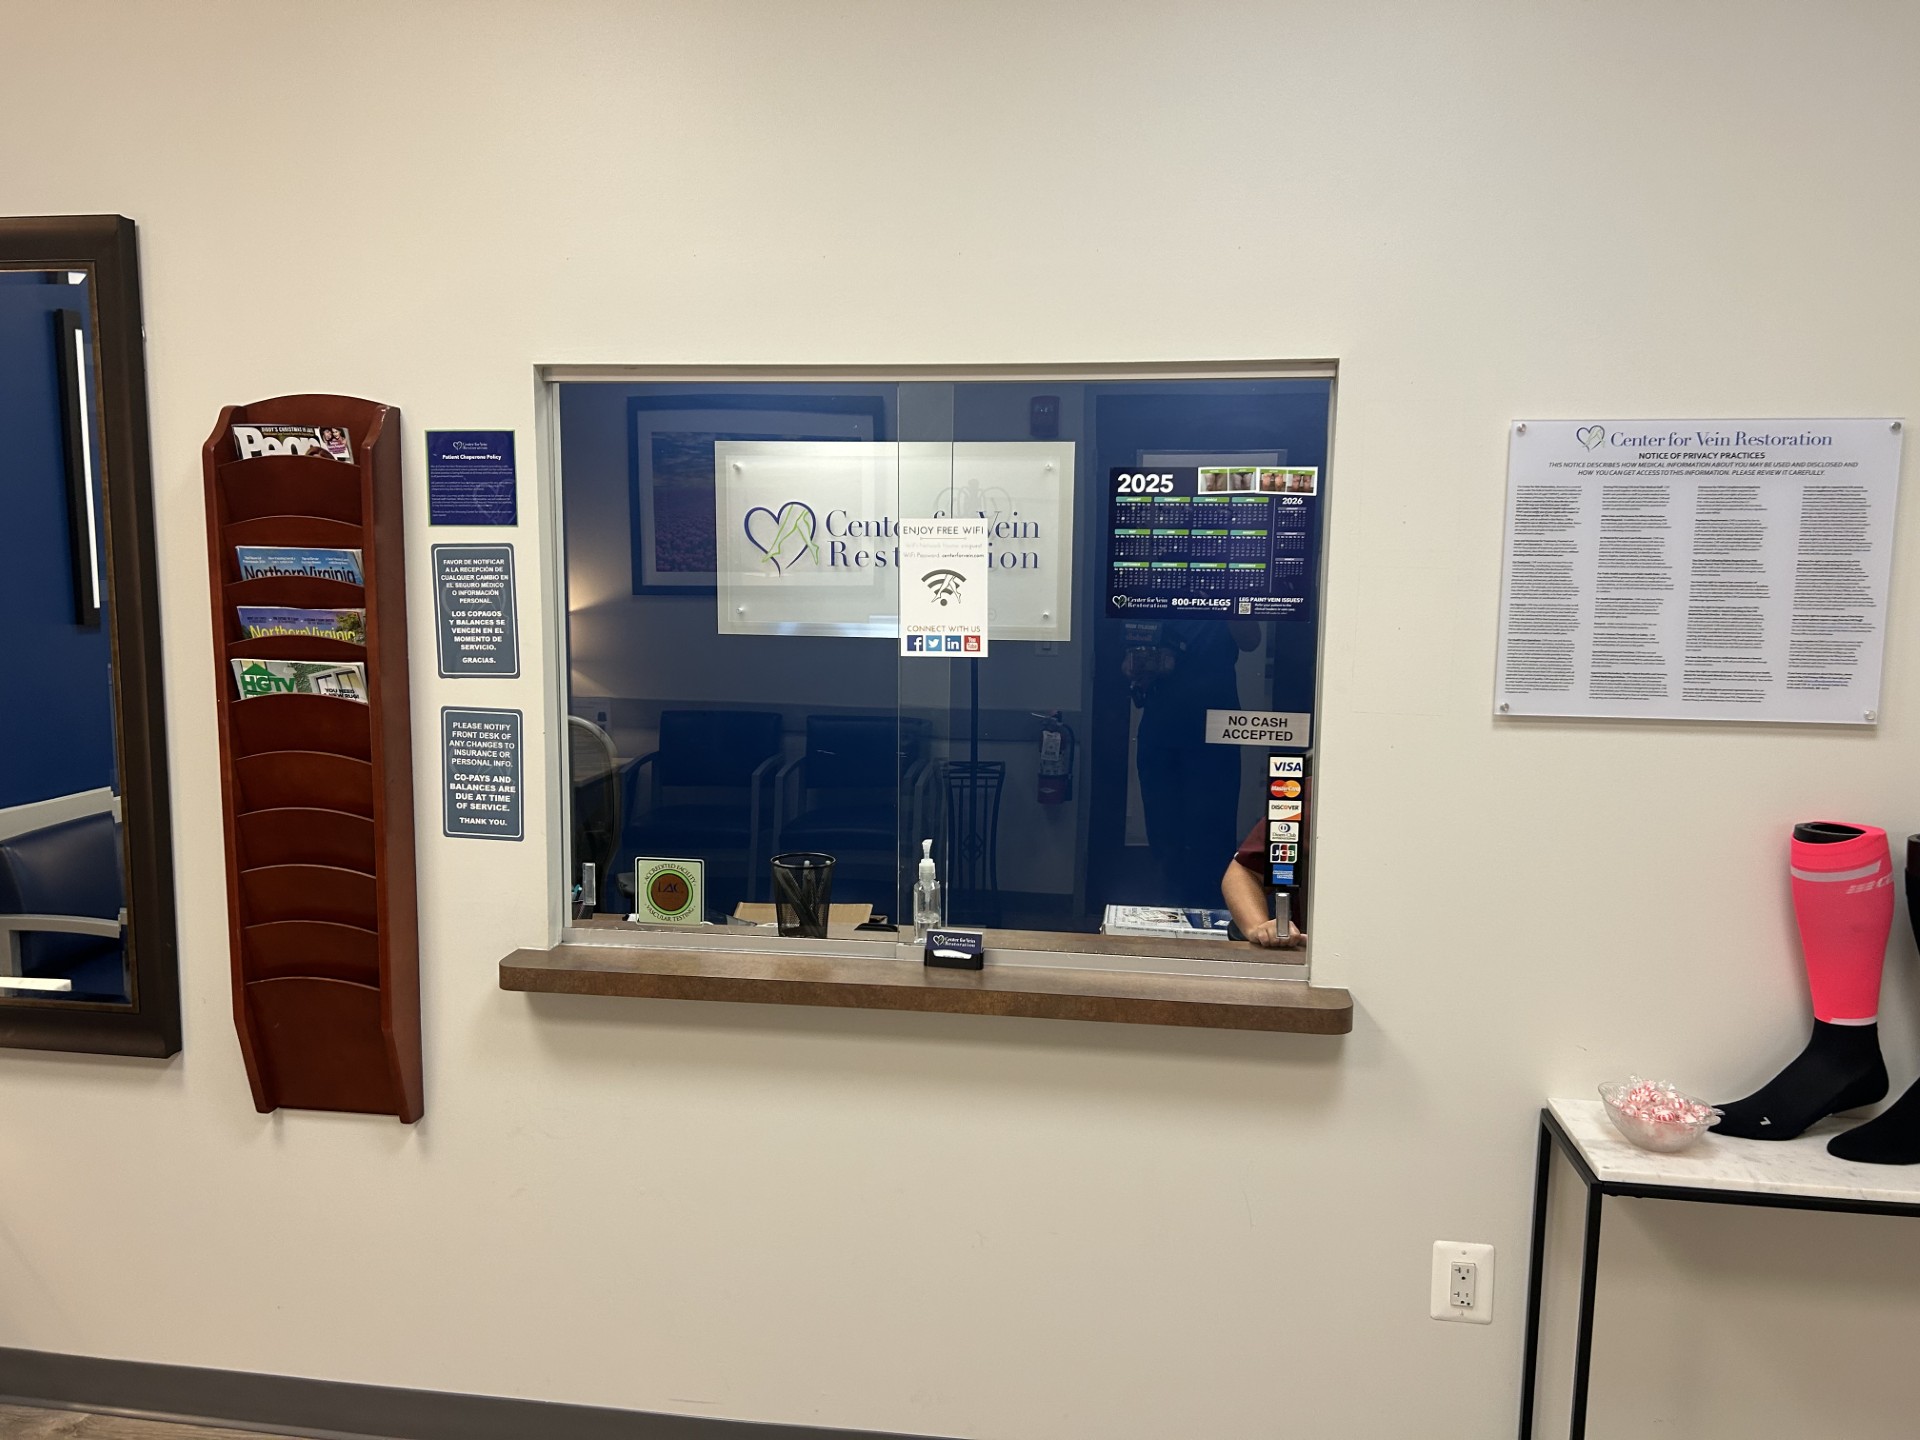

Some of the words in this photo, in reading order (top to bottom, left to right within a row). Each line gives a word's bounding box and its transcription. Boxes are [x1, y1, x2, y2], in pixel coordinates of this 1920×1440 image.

[1611, 432, 1665, 447] Center
[1668, 432, 1692, 446] for
[1695, 431, 1730, 446] Vein
[1735, 431, 1832, 446] Restoration
[1118, 474, 1173, 493] 2025
[1282, 497, 1303, 505] 2026
[825, 509, 900, 538] Cent
[903, 526, 933, 535] ENJOY
[937, 526, 958, 534] FREE
[963, 526, 984, 534] WIFI
[826, 540, 1040, 569] Restion
[1172, 598, 1231, 606] 800-FIX-LEGS
[947, 638, 959, 650] in
[240, 675, 296, 693] HGTV
[1228, 716, 1247, 726] NO
[1251, 717, 1288, 728] CASH
[484, 723, 511, 731] NOTIFY
[1222, 729, 1293, 741] ACCEPTED
[466, 741, 503, 749] CHANGES
[454, 749, 497, 758] INSURANCE
[451, 758, 491, 767] PERSONAL
[1273, 762, 1302, 771] VISA
[454, 774, 490, 782] CO-PAYS
[493, 775, 511, 783] AND
[450, 783, 496, 792] BALANCES
[489, 794, 511, 802] TIME
[456, 802, 467, 810] OF
[470, 803, 510, 811] SERVICE.
[459, 817, 487, 825] THANK
[644, 863, 676, 881] ACCREDITED
[676, 865, 696, 883] FACILITY
[646, 905, 671, 921] VASCULAR
[673, 908, 694, 922] TESTING
